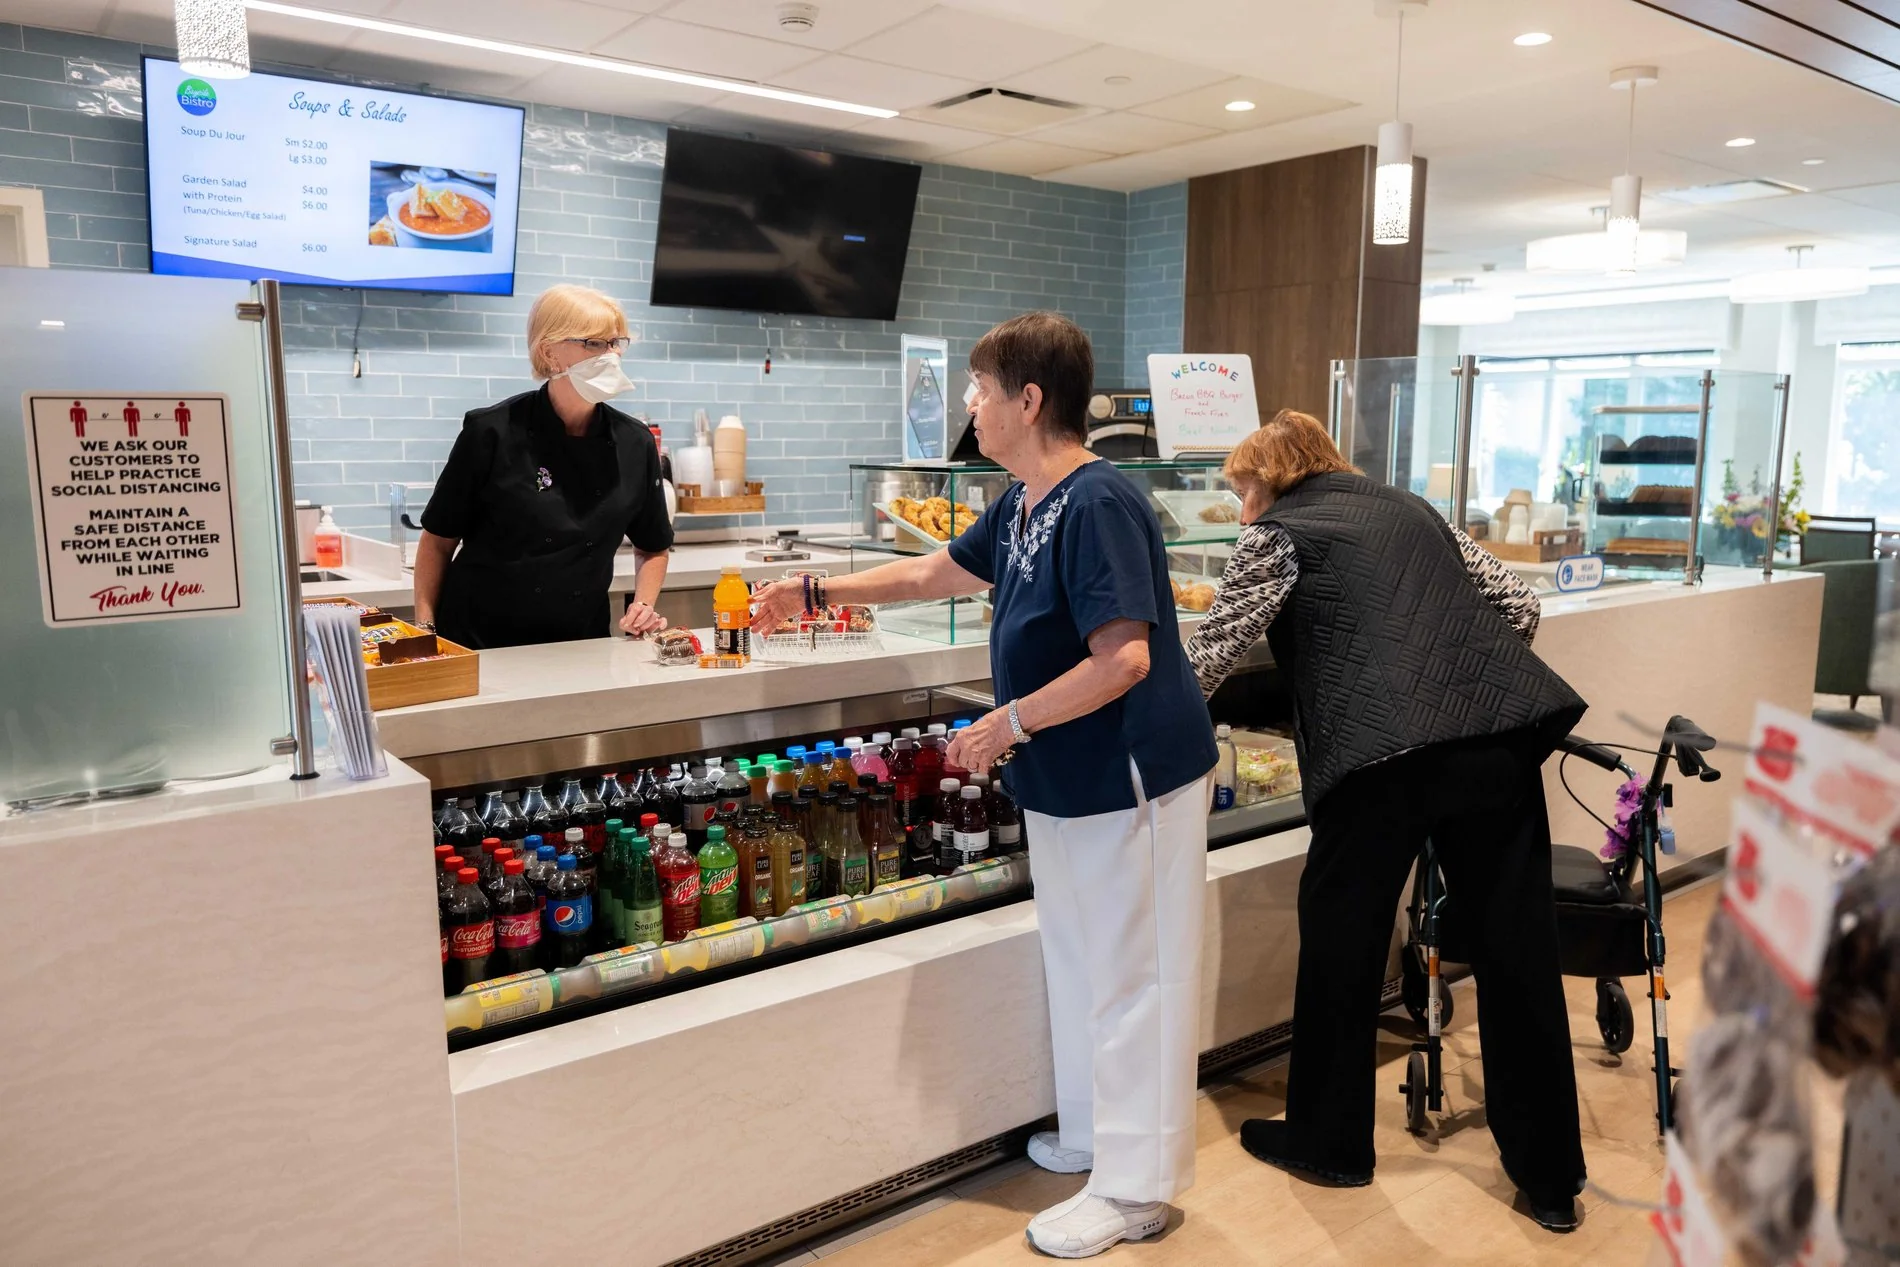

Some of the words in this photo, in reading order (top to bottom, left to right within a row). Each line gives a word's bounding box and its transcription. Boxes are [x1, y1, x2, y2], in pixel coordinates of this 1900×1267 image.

[181, 95, 214, 108] Bistro
[289, 91, 331, 120] Soups
[339, 98, 354, 117] &
[361, 101, 407, 123] Salads
[181, 126, 207, 138] Soup
[208, 128, 224, 139] Du
[225, 130, 245, 141] Jour
[285, 137, 299, 148] Sm
[302, 139, 328, 151] $2.00
[288, 154, 299, 165] Lg
[301, 154, 327, 165] $3.00
[182, 174, 218, 187] Garden
[221, 177, 247, 189] Salad
[183, 191, 205, 202] with
[207, 192, 243, 203] Protein
[302, 185, 328, 196] $4.00
[302, 200, 328, 211] $6.00
[262, 210, 287, 222] Salad)
[184, 235, 230, 249] Signature
[232, 238, 257, 249] Salad
[302, 243, 328, 254] $6.00
[1171, 361, 1239, 382] WELCOME
[80, 441, 109, 451] WE
[114, 441, 147, 451] ASK
[152, 440, 188, 451] OUR
[69, 455, 173, 467] CUSTOMERS
[178, 454, 200, 464] TO
[71, 470, 115, 481] HELP
[120, 468, 201, 480] PRACTICE
[51, 485, 116, 496] SOCIAL
[120, 481, 221, 494] DISTANCING
[89, 508, 173, 520] MAINTAIN
[178, 507, 189, 517] A
[74, 524, 119, 535] SAFE
[123, 520, 206, 534] DISTANCE
[61, 539, 111, 551] FROM
[116, 537, 161, 548] EACH
[166, 533, 220, 545] OTHER
[76, 552, 132, 564] WHILE
[137, 547, 209, 561] WAITING
[116, 565, 133, 576] IN
[138, 563, 175, 575] LINE
[90, 585, 154, 612] Thank
[806, 864, 821, 872] URE
[881, 859, 898, 867] PURE
[790, 866, 805, 874] ORGANIC
[847, 866, 865, 874] PURE
[847, 873, 865, 881] LEAF
[453, 920, 495, 944] Coca-Cola
